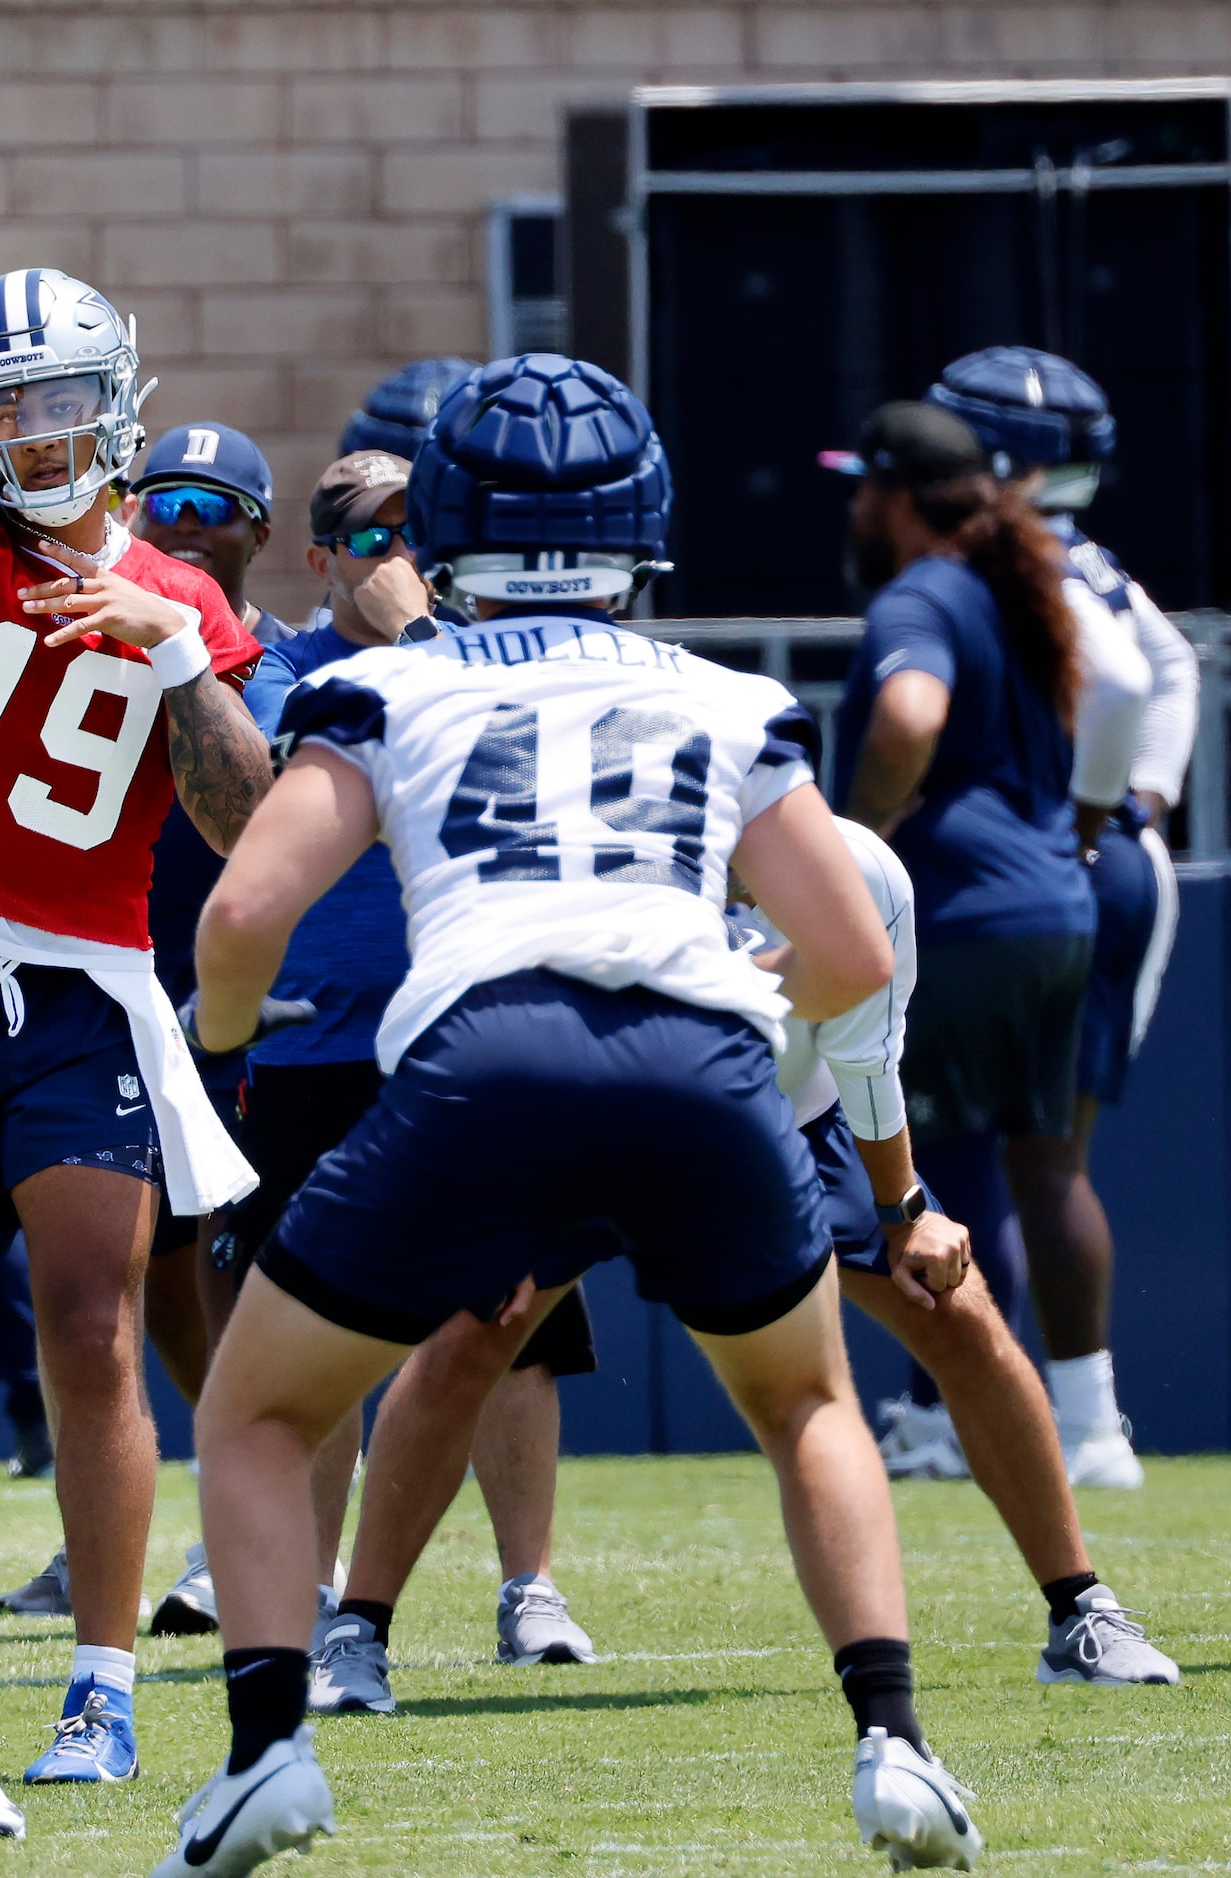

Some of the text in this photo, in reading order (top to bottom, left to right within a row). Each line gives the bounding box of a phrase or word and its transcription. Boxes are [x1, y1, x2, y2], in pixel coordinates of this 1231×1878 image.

[0, 352, 44, 367] COWBOYS
[181, 429, 219, 464] D
[506, 577, 592, 594] COWBOYS
[454, 624, 684, 674] HOLLER
[439, 702, 711, 896] 49
